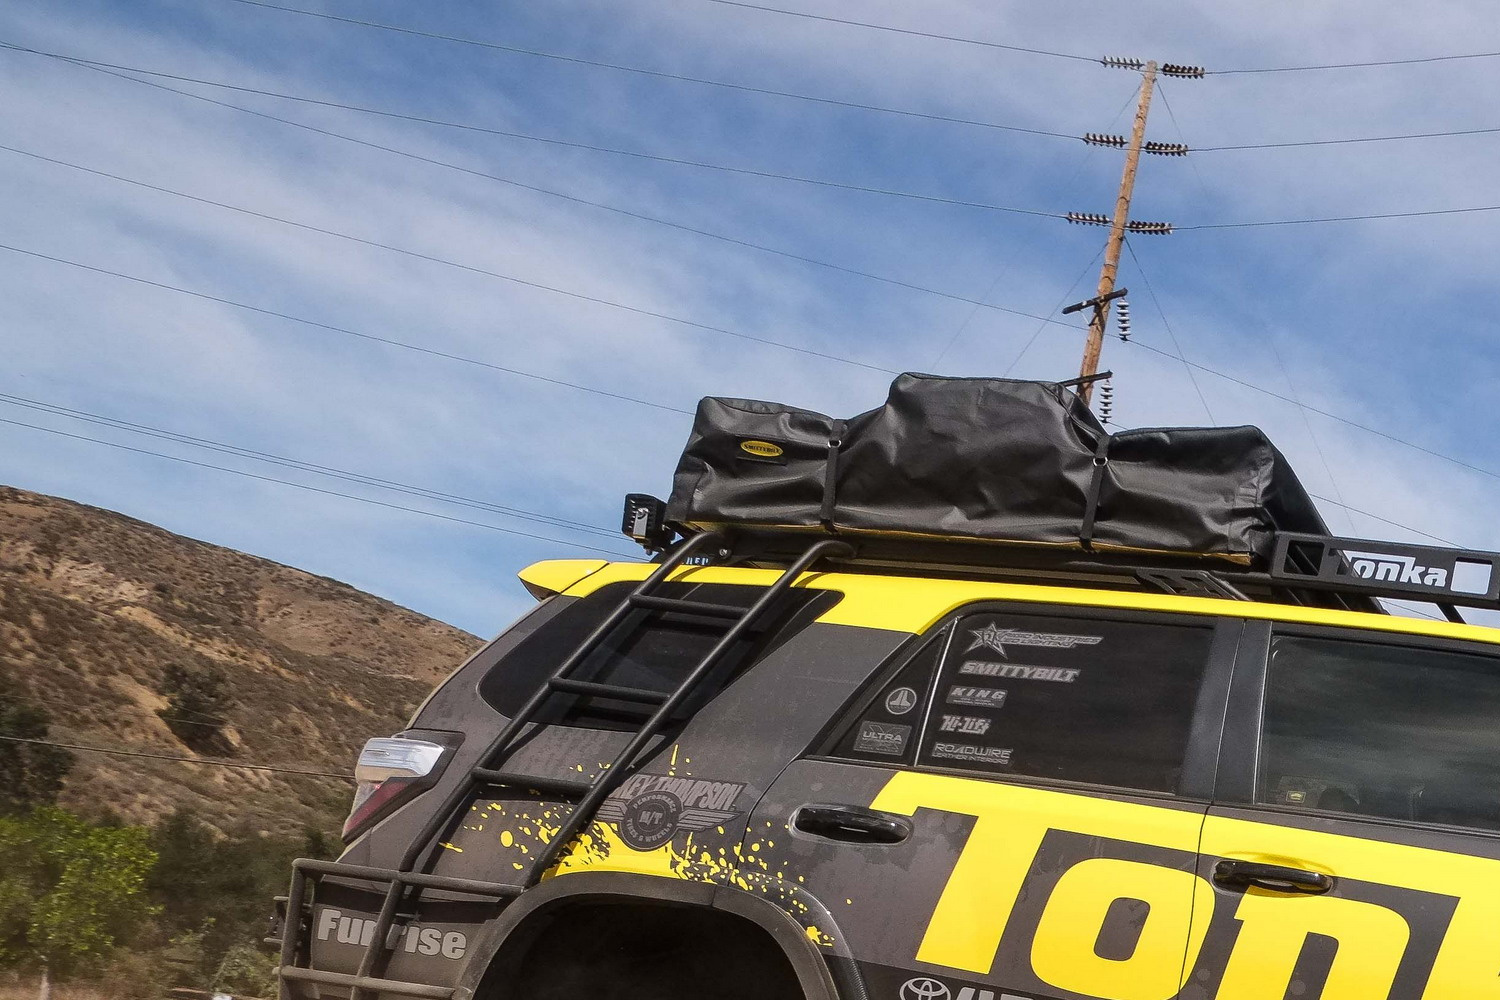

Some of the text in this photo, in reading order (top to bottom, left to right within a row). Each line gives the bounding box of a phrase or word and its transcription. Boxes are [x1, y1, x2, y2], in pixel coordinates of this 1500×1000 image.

[959, 662, 1080, 683] SMITTYBILT
[952, 687, 1006, 700] KING
[863, 731, 902, 742] ULTRA
[934, 743, 1012, 759] ROADWIRE
